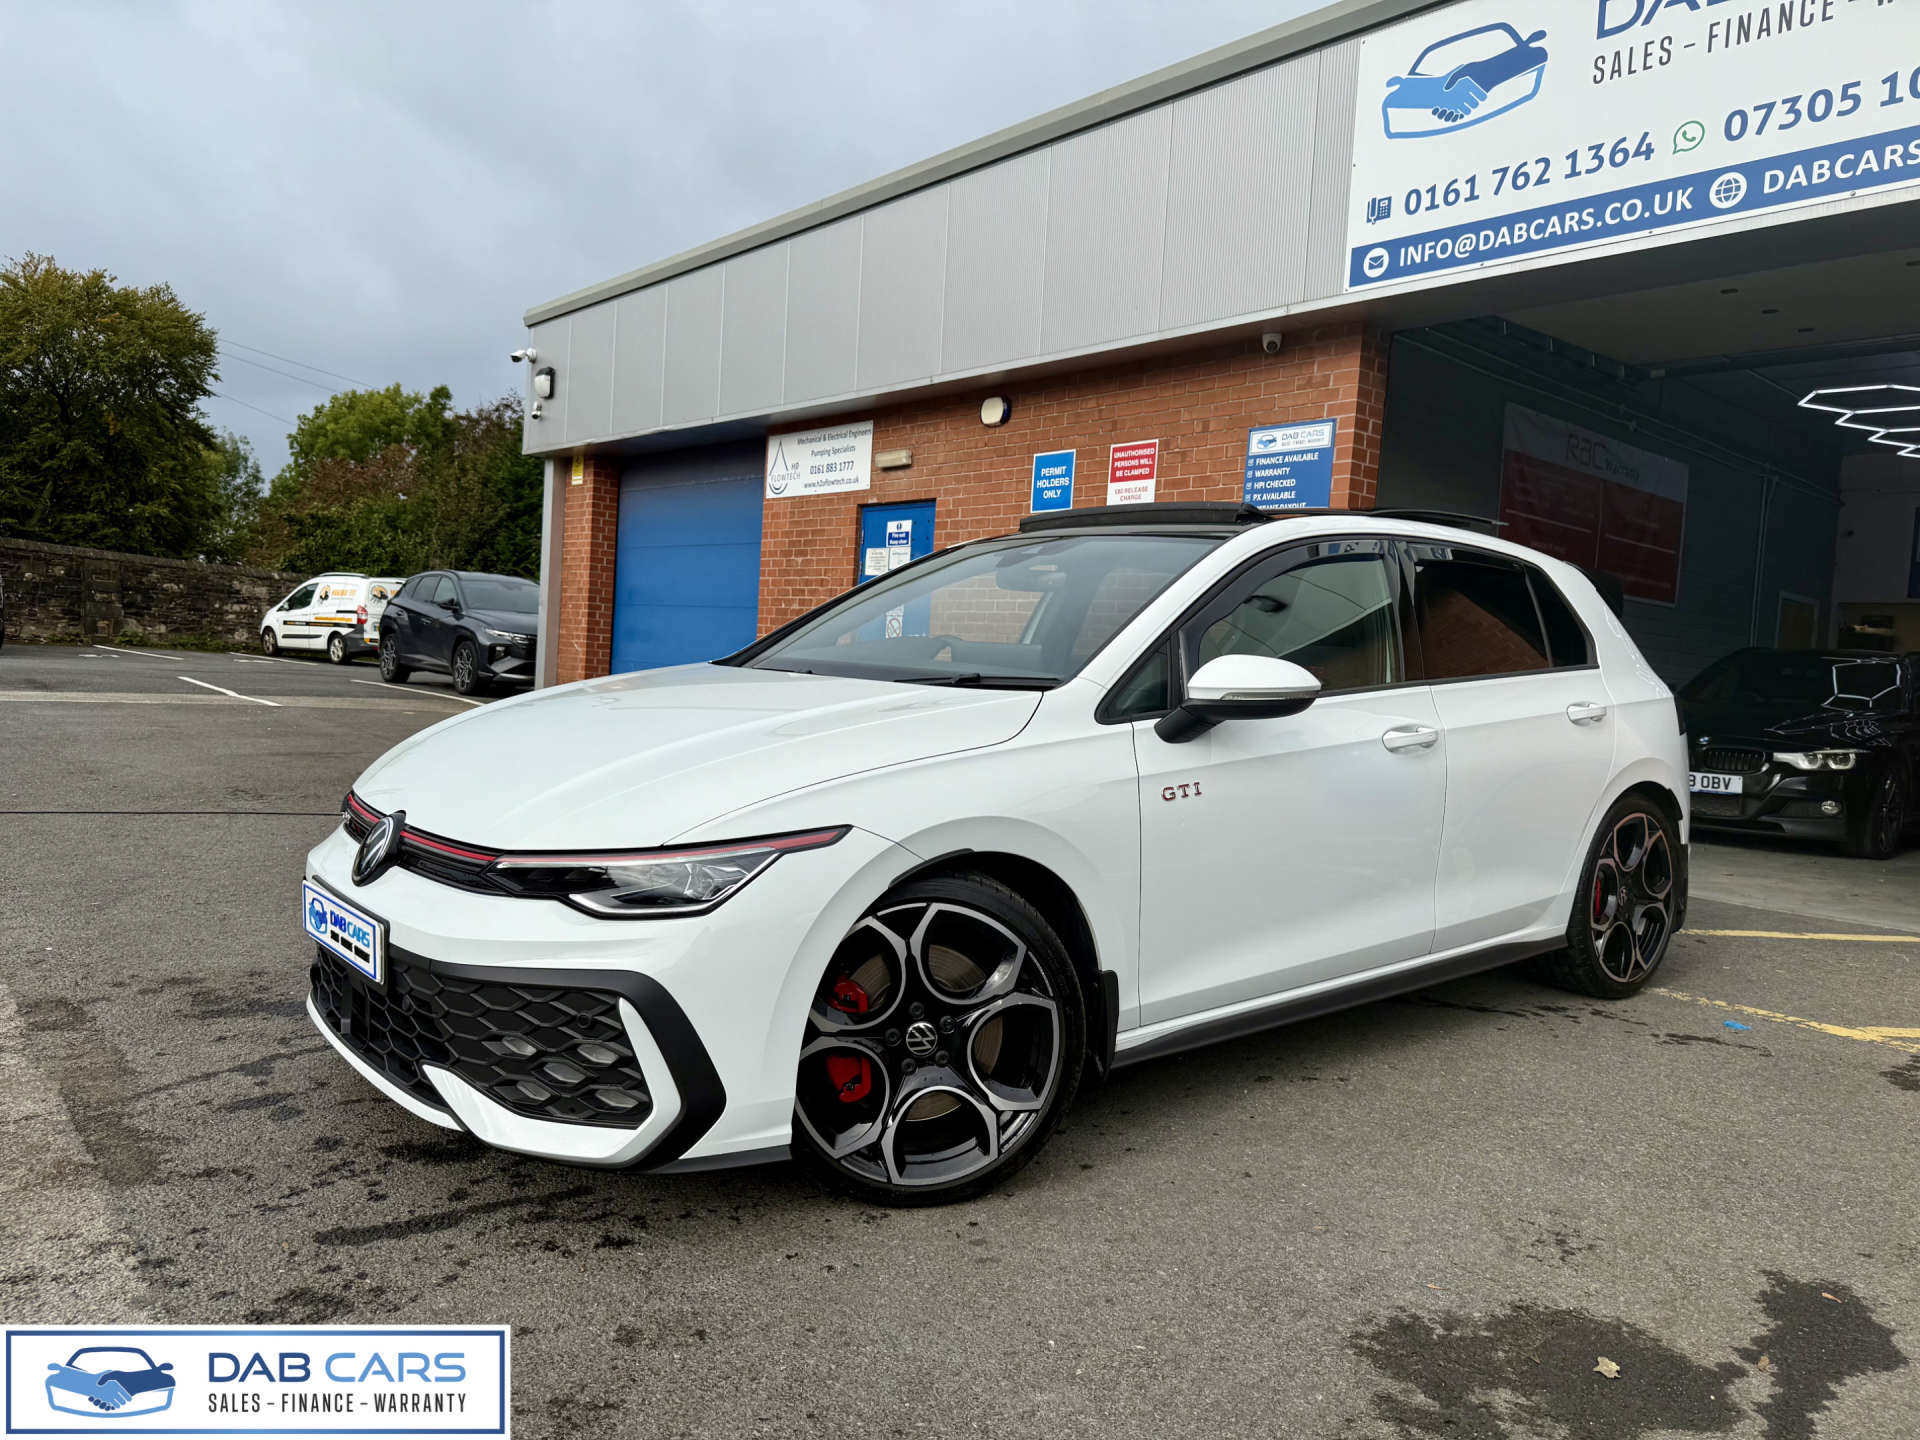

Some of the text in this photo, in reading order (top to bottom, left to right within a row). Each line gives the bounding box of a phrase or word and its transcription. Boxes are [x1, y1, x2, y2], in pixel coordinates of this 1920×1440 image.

[1593, 35, 1673, 85] SALES
[1707, 0, 1835, 53] FINANCE
[1403, 173, 1480, 216] 0161
[1492, 156, 1551, 195] 762
[1563, 131, 1655, 181] 1364
[1723, 80, 1861, 142] 07305
[1399, 187, 1694, 267] INFO@DABCARS.CO.UK
[1114, 448, 1155, 458] UNAUTHORISED
[1256, 452, 1319, 465] FINANCE AVAILABLE
[810, 464, 824, 475] 0161
[839, 460, 855, 472] 1777
[1041, 465, 1067, 477] PERMIT
[1115, 467, 1150, 477] BE CLAMPED
[1255, 467, 1290, 477] WARRANTY
[1036, 477, 1070, 489] HOLDERS
[1254, 479, 1296, 489] HPI CHECKED
[1042, 489, 1062, 499] ONLY
[1253, 490, 1296, 501] PX AVAILABLE
[1701, 776, 1731, 790] OBV
[1162, 782, 1202, 801] GTI
[330, 910, 347, 933] DAB
[347, 921, 370, 948] CARS
